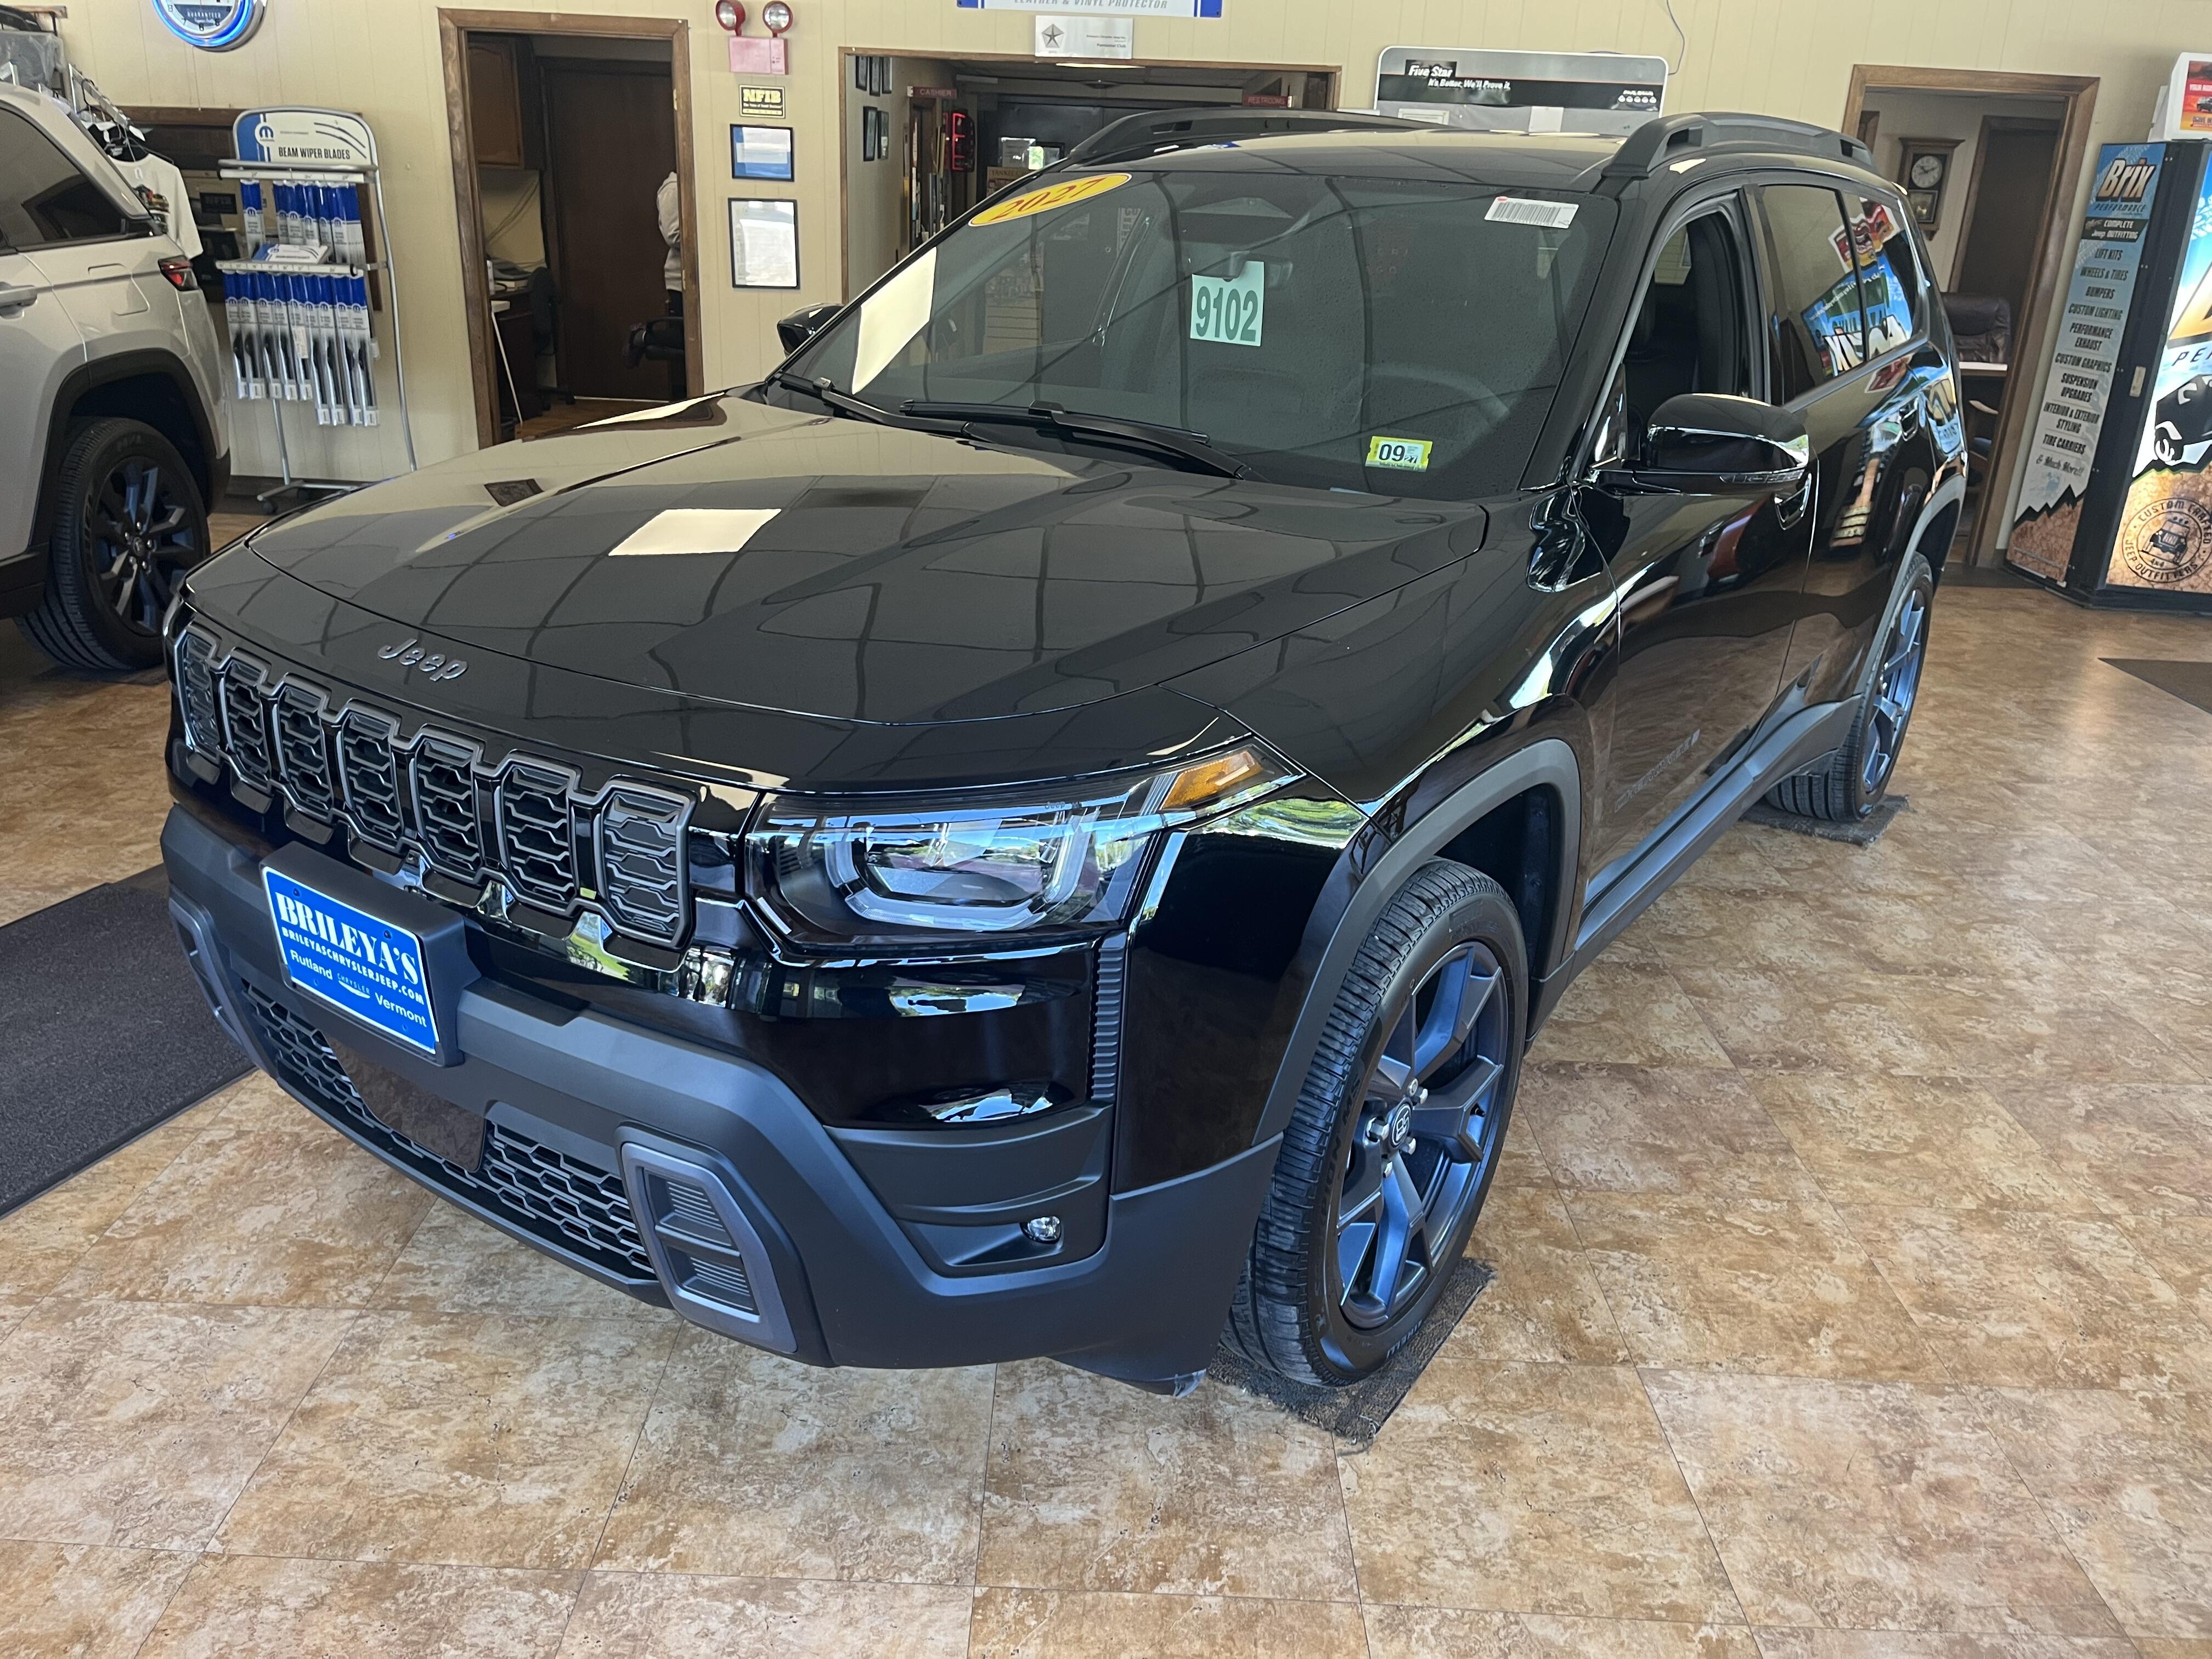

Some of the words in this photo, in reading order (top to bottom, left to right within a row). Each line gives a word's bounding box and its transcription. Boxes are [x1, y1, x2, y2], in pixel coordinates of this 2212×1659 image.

[1108, 0, 1167, 9] PROTECTOR
[1408, 65, 1430, 77] Five
[1430, 65, 1453, 77] Star
[1428, 78, 1439, 87] It's
[1463, 79, 1482, 89] We'll
[1482, 80, 1503, 90] Prove
[743, 89, 781, 103] NFIB
[279, 147, 298, 157] BEAM
[299, 148, 322, 159] WIPER
[324, 149, 350, 160] BLADES
[2096, 158, 2157, 202] Brix
[989, 177, 1107, 222] 2027
[2095, 203, 2146, 212] PERFORMANCE
[2104, 220, 2134, 228] COMPLETE
[2092, 230, 2106, 239] Jeep
[2107, 230, 2138, 239] OUTFITTING
[2095, 249, 2109, 259] LIFT
[2107, 250, 2123, 261] KITS
[2080, 267, 2105, 279] WHEELS
[2104, 270, 2110, 279] &
[2111, 269, 2129, 281] TIRES
[2085, 286, 2115, 299] BUMPERS
[1196, 286, 1259, 342] 9102
[2068, 303, 2096, 316] CUSTOM
[2095, 307, 2123, 320] LIGHTING
[2069, 323, 2113, 339] PERFORMANCE
[2075, 337, 2102, 351] EXHAUST
[2055, 353, 2082, 367] CUSTOM
[2081, 357, 2112, 373] GRAPHICS
[2061, 373, 2099, 390] SUSPENSION
[2061, 387, 2092, 403] UPGRADES
[2043, 402, 2070, 418] INTERIOR
[2069, 409, 2074, 418] &
[2073, 409, 2100, 424] EXTERIOR
[2056, 419, 2082, 433] STYLING
[1379, 444, 1406, 462] 09
[2042, 434, 2057, 446] TIRE
[2057, 438, 2086, 455] CARRIERS
[2138, 500, 2185, 522] CUSTOM
[2187, 504, 2212, 545] CRAFTED
[2125, 539, 2138, 562] JEEP
[2135, 562, 2198, 580] OUTFITTERS
[377, 638, 469, 682] Jeep
[275, 892, 419, 985] BRILEYA'S
[281, 927, 425, 1005] BRILEYASCHRYSLERJEEP.COM
[290, 949, 333, 980] Rutland
[337, 973, 370, 995] CHRYSLER
[374, 992, 427, 1028] Vermont
